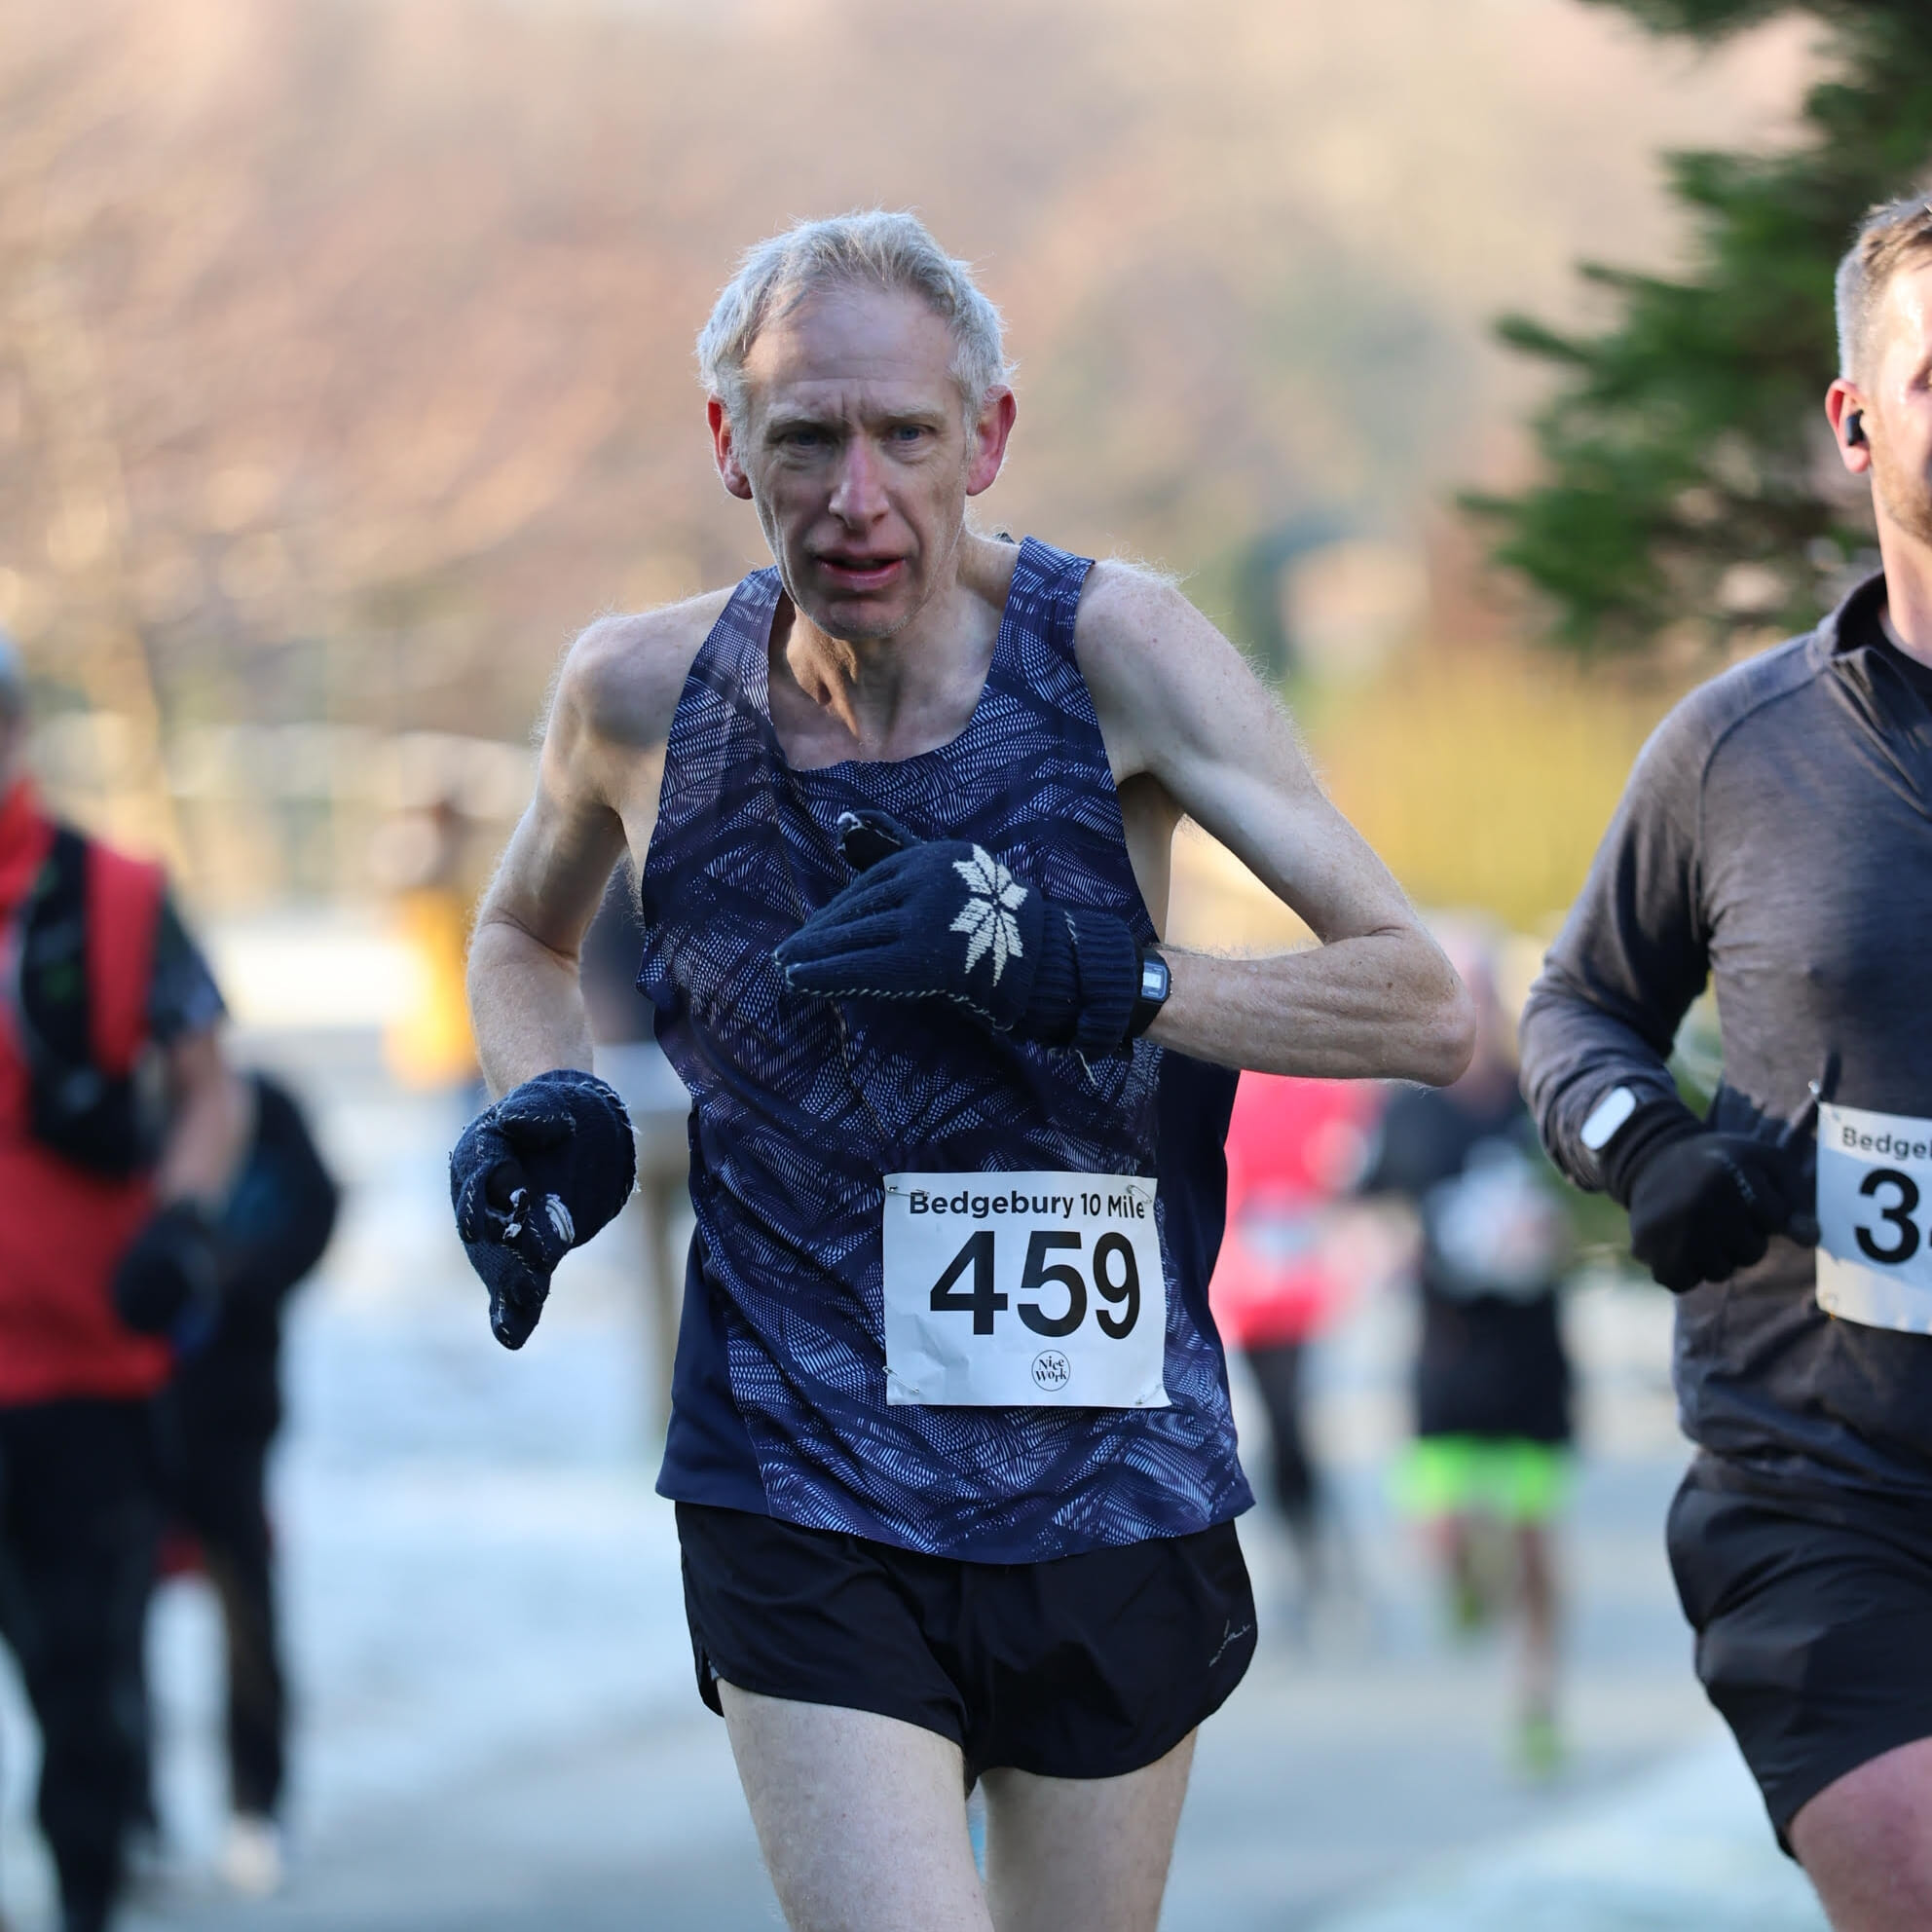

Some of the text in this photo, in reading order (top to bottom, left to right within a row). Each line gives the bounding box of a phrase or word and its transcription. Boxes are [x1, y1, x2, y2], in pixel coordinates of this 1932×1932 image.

[910, 1190, 1145, 1219] Bedgebury 10 Mile
[1854, 1169, 1932, 1265] 3
[930, 1231, 1140, 1340] 459
[1035, 1368, 1067, 1383] Work
[1038, 1356, 1064, 1370] Nice
